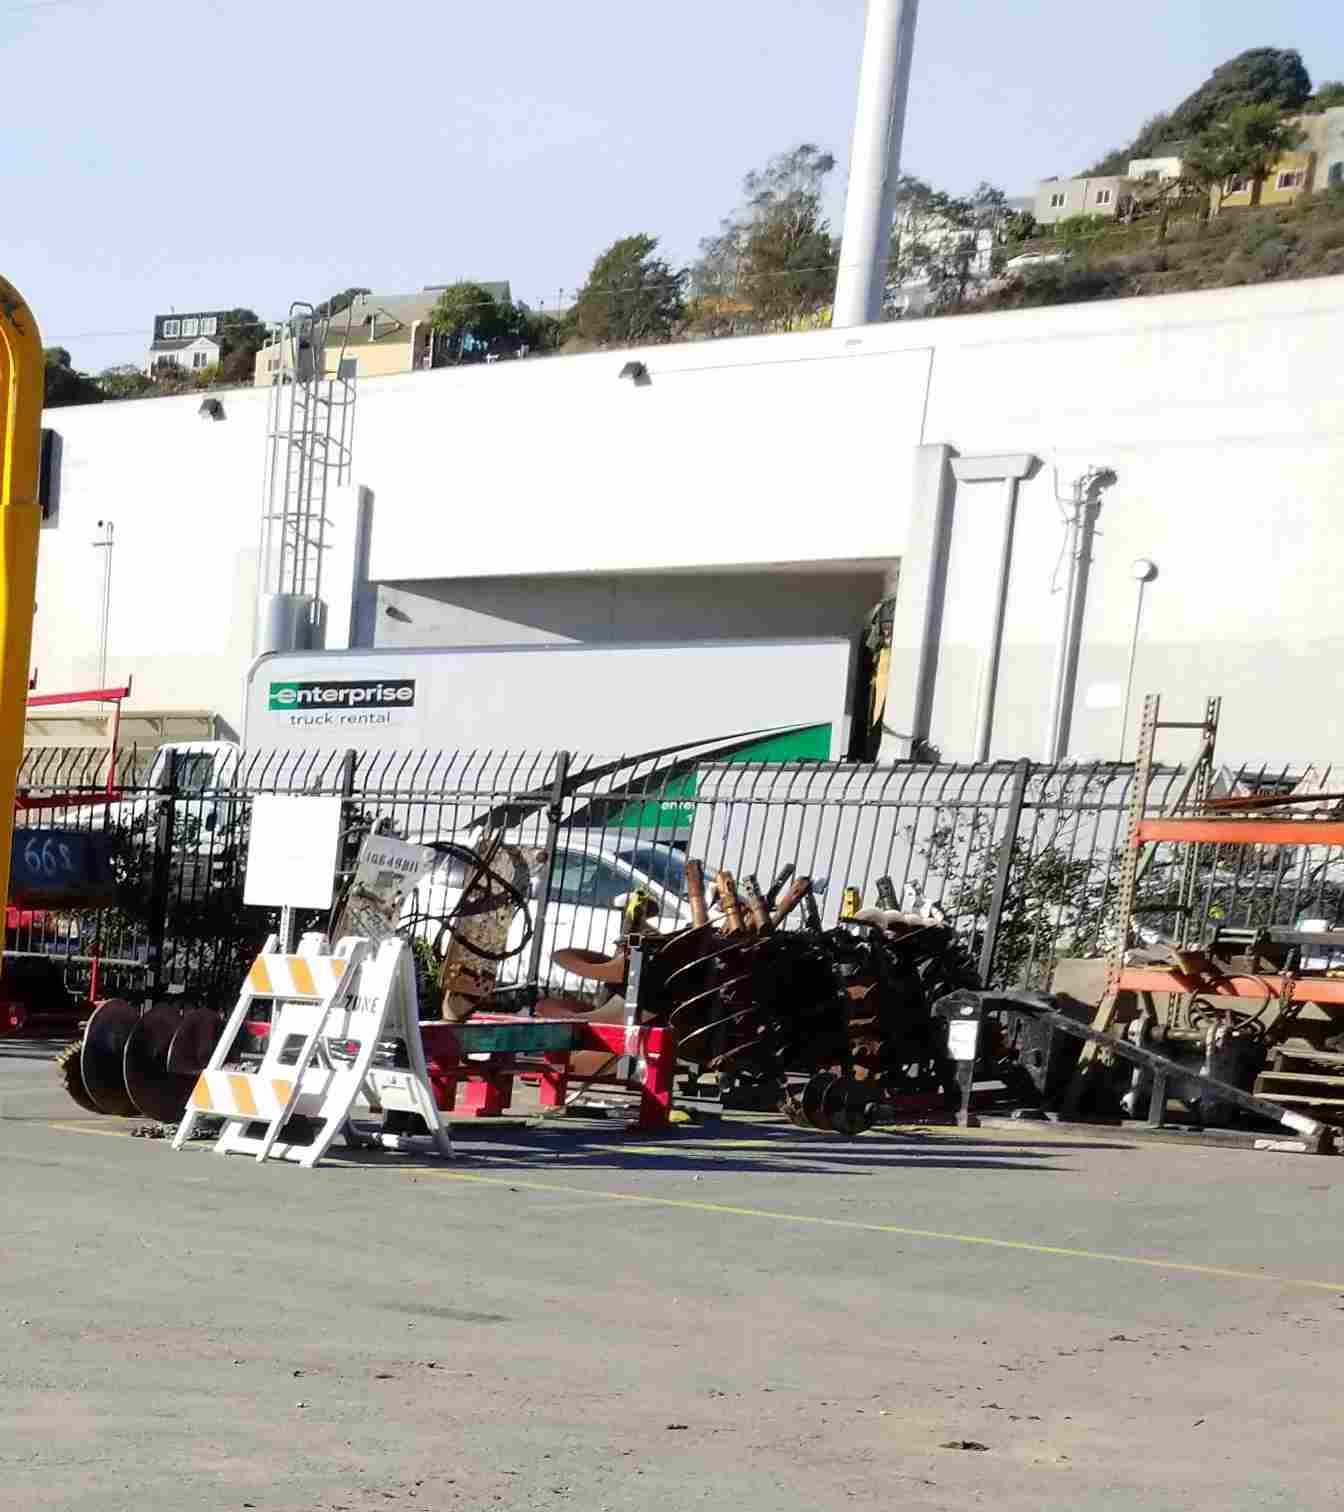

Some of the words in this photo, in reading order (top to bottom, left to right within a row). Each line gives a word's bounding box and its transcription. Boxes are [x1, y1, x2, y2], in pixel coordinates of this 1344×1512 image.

[270, 683, 413, 706] enterprise
[290, 712, 334, 725] truck
[340, 711, 391, 725] rental
